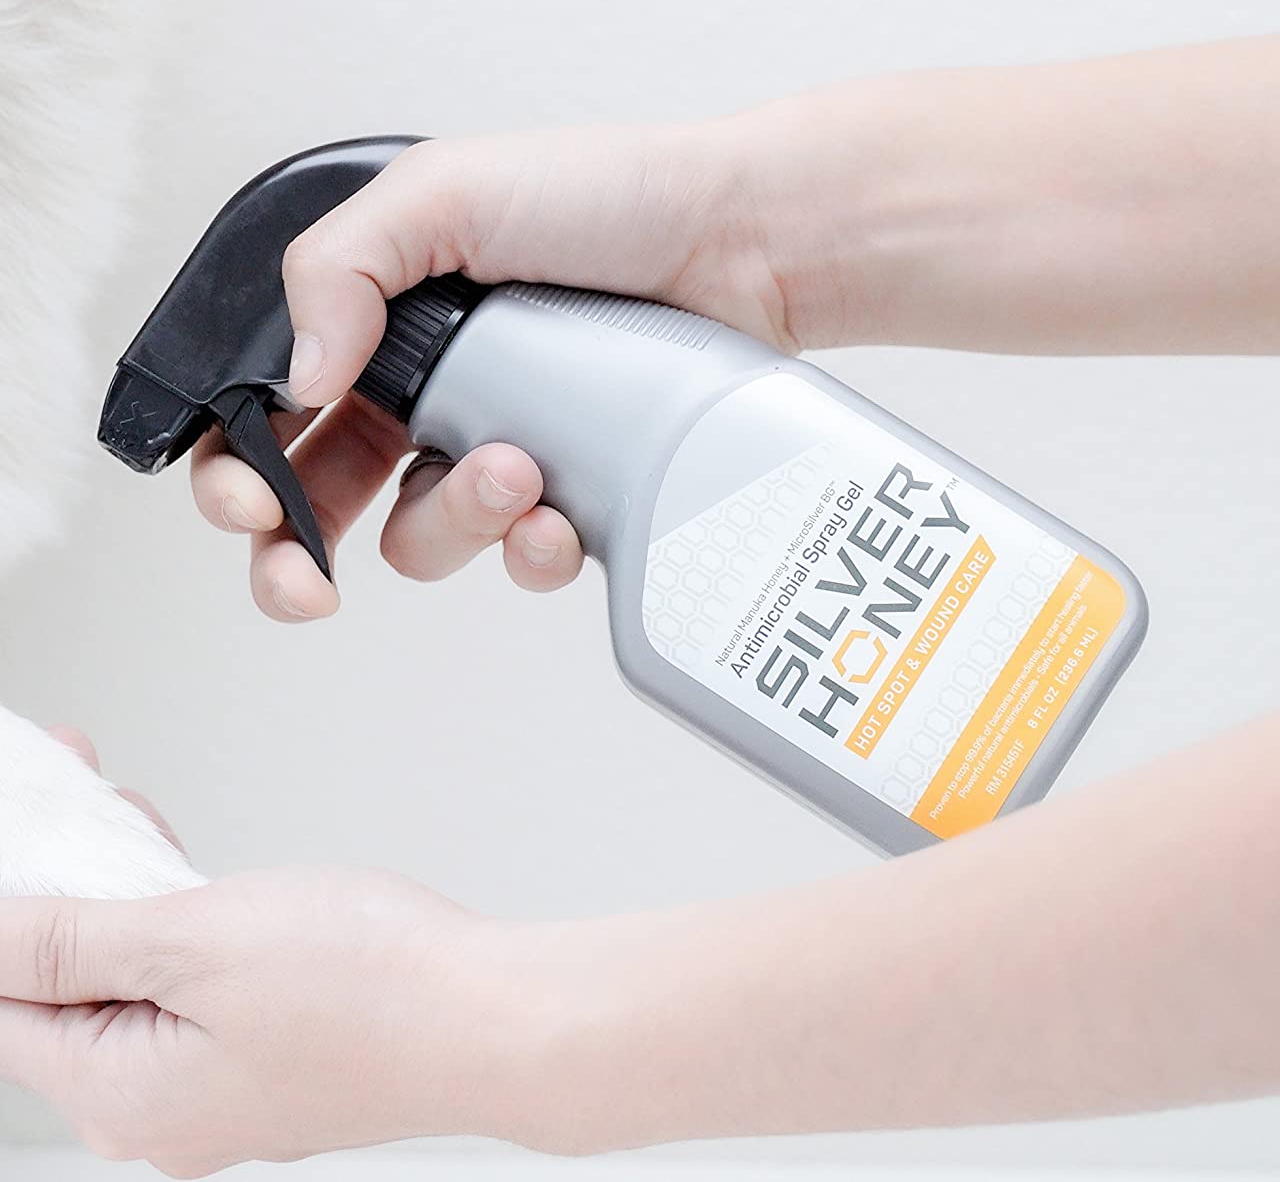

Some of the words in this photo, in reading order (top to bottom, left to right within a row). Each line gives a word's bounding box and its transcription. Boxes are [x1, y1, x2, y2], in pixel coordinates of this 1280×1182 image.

[714, 629, 743, 667] Natural
[736, 591, 767, 631] Manuka
[761, 560, 789, 595] Honey
[786, 501, 826, 555] MicroSilver
[730, 562, 809, 678] Antimicrobial
[802, 513, 846, 563] Spray
[836, 480, 863, 510] Gel
[755, 463, 932, 708] SILVER
[798, 491, 969, 738] HONEY
[1044, 617, 1062, 639] start
[853, 714, 883, 751] HOT
[875, 669, 912, 716] SPOT
[904, 654, 922, 671] &
[913, 593, 961, 656] WOUND
[952, 549, 990, 595] CARE
[1038, 636, 1050, 648] to
[1007, 645, 1046, 696] immediately
[957, 760, 986, 798] Powerful
[980, 731, 1004, 763] natural
[1035, 653, 1054, 675] Safe
[1048, 642, 1062, 656] for
[986, 691, 1014, 727] bacteria
[1025, 717, 1039, 729] 8
[1032, 702, 1049, 719] FL
[1042, 685, 1059, 704] OZ
[963, 733, 987, 763] 99.9%
[980, 724, 993, 736] of
[946, 779, 958, 791] to
[952, 761, 971, 783] stop
[984, 775, 1002, 795] RM
[928, 789, 952, 820] Proven
